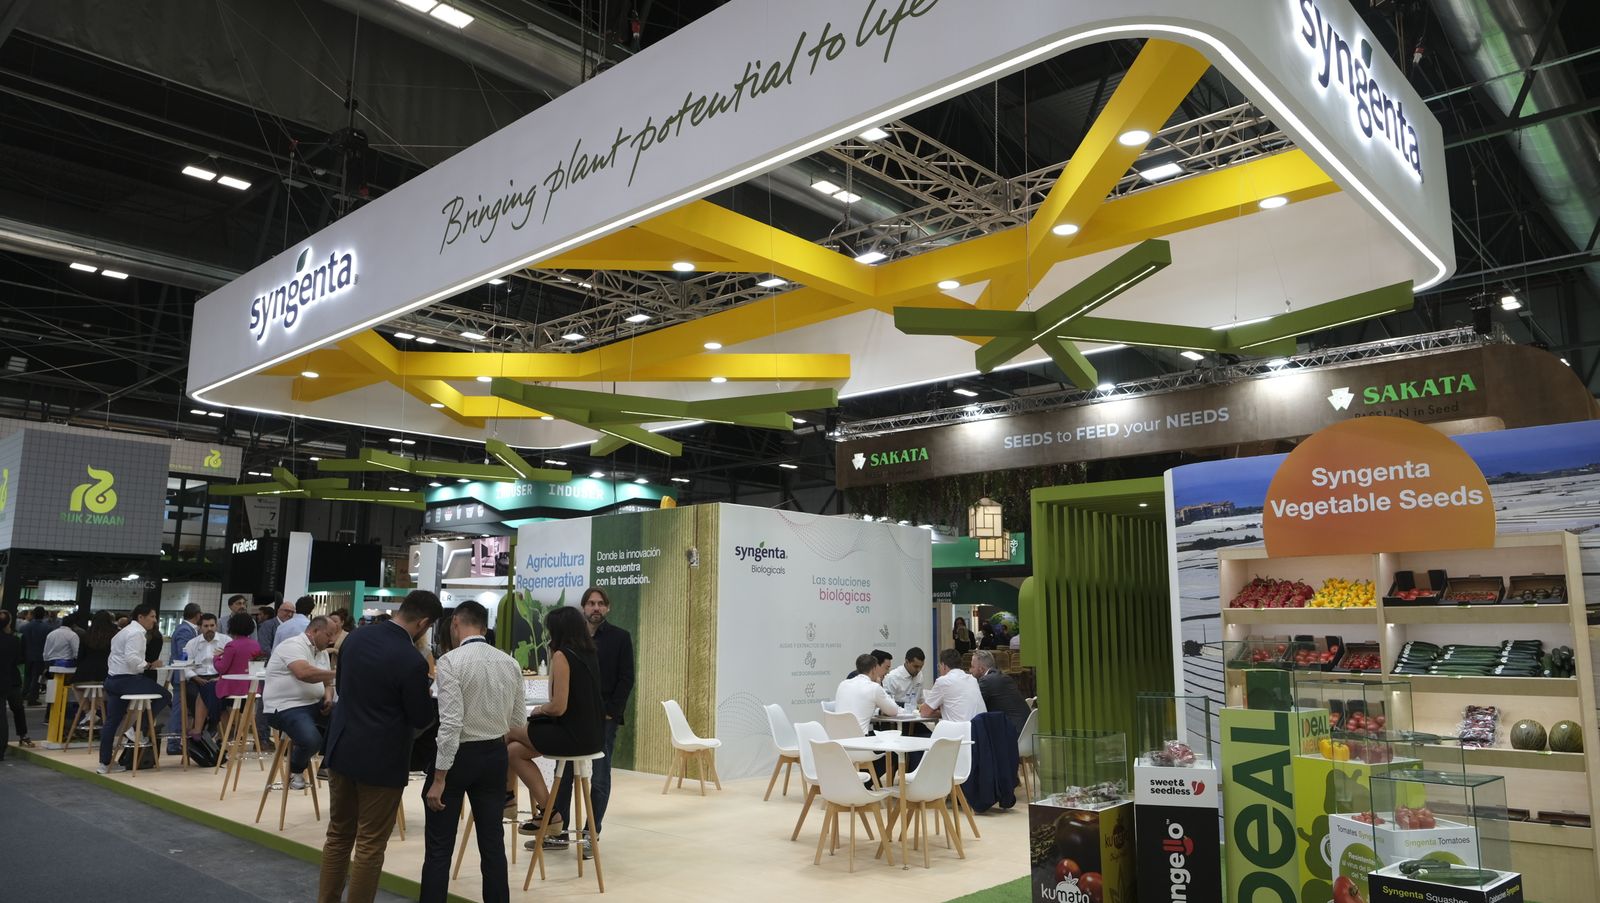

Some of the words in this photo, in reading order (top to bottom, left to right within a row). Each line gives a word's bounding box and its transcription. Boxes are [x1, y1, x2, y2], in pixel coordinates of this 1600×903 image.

[1300, 0, 1421, 175] syngenta
[440, 180, 537, 254] Bringing
[542, 128, 631, 224] plant
[628, 32, 806, 187] potential
[807, 22, 845, 75] to
[856, 0, 938, 63] life
[250, 251, 354, 342] syngenta
[1363, 373, 1477, 405] SAKATA
[1428, 400, 1459, 415] Seed
[1004, 431, 1053, 449] SEEDS
[1057, 430, 1072, 443] to
[1076, 423, 1119, 441] FEED
[1123, 418, 1160, 438] your
[1166, 407, 1230, 429] NEEDS
[870, 447, 929, 467] SAKATA
[1312, 460, 1431, 490] Syngenta
[1270, 493, 1391, 521] Vegetable
[1399, 485, 1484, 511] Seeds
[85, 514, 125, 527] ZWAAN
[526, 551, 585, 570] Agricultura
[597, 549, 618, 561] Donde
[619, 549, 625, 560] la
[626, 547, 661, 559] innovación
[735, 544, 786, 562] syngenta
[596, 565, 604, 574] se
[606, 562, 641, 573] encuentra
[751, 564, 786, 576] Biologicals
[86, 578, 156, 590] HYDROPONICS
[516, 572, 584, 593] Regenerativa
[596, 577, 608, 586] con
[610, 576, 616, 585] la
[617, 574, 651, 585] tradición.
[812, 575, 826, 586] Las
[827, 575, 871, 588] soluciones
[819, 588, 871, 605] biológicas
[856, 605, 870, 614] son
[1150, 778, 1176, 787] sweet
[1150, 786, 1191, 796] seedless
[1337, 824, 1358, 837] Tomates
[1438, 836, 1471, 845] Tomatoes
[1041, 883, 1090, 903] kumato
[1382, 885, 1424, 900] Syngenta
